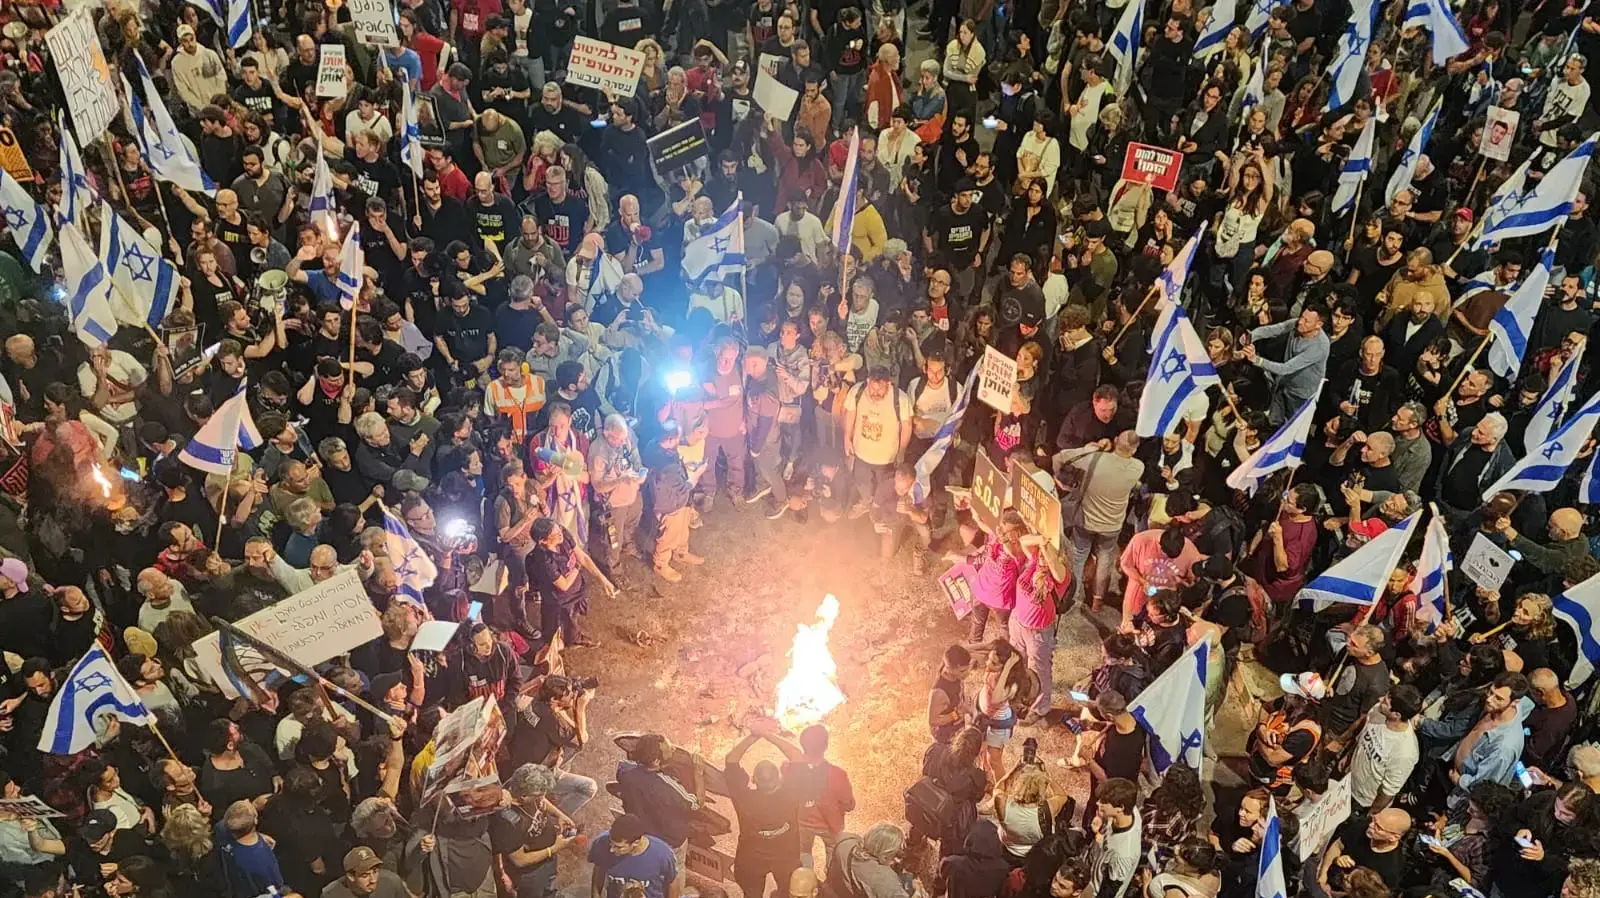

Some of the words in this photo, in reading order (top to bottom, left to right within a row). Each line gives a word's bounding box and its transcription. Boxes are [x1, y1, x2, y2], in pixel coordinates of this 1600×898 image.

[572, 43, 617, 60] למיטוט
[624, 54, 639, 65] די
[570, 70, 601, 84] עכשיו
[571, 55, 634, 79] החטופים
[1020, 486, 1037, 514] DEAL
[1021, 473, 1050, 510] HOSTAGE
[1020, 498, 1037, 526] NOW
